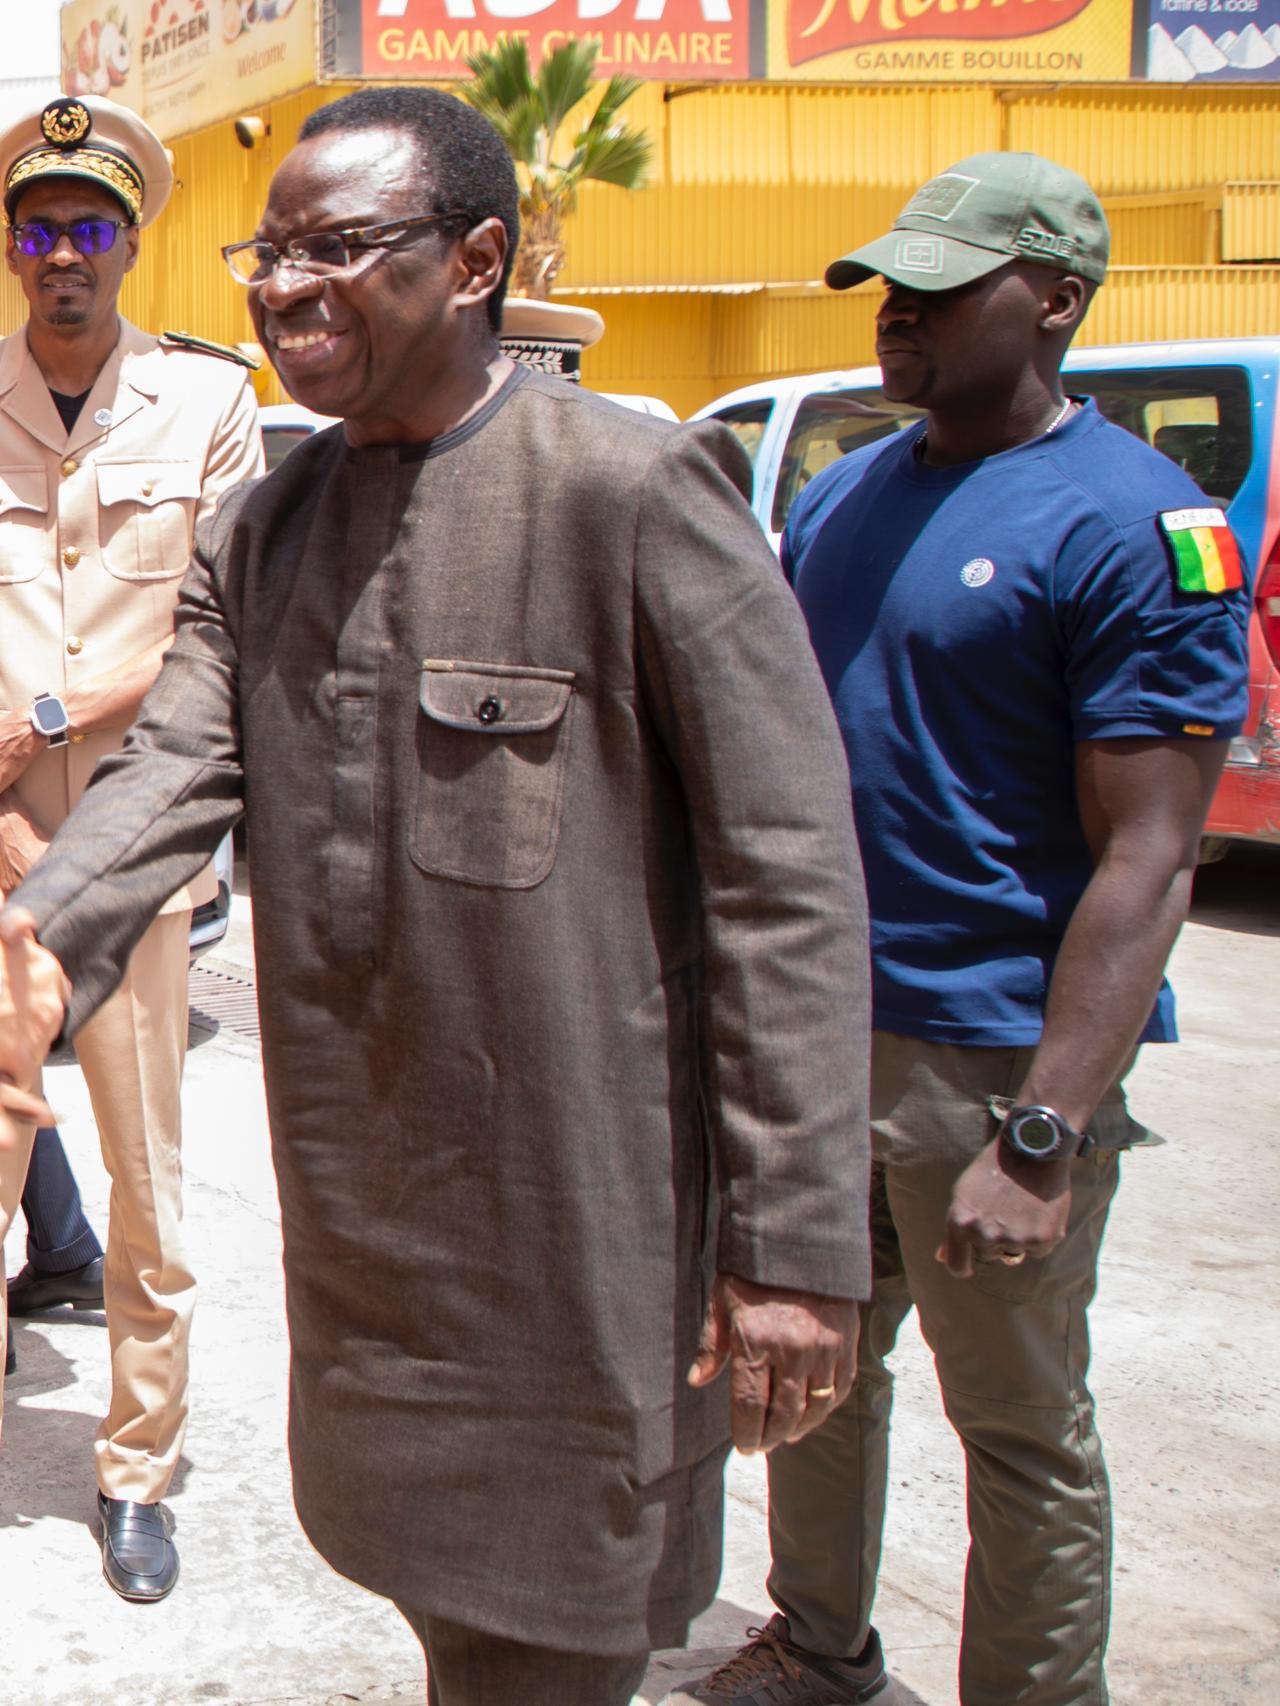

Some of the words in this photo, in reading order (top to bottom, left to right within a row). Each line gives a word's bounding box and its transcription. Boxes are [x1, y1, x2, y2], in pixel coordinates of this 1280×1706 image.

[142, 12, 209, 64] PATISEN
[542, 30, 732, 64] CLINAIRE
[237, 43, 287, 78] Welcome
[855, 51, 953, 70] GAMME
[963, 51, 1084, 70] BOUILLON
